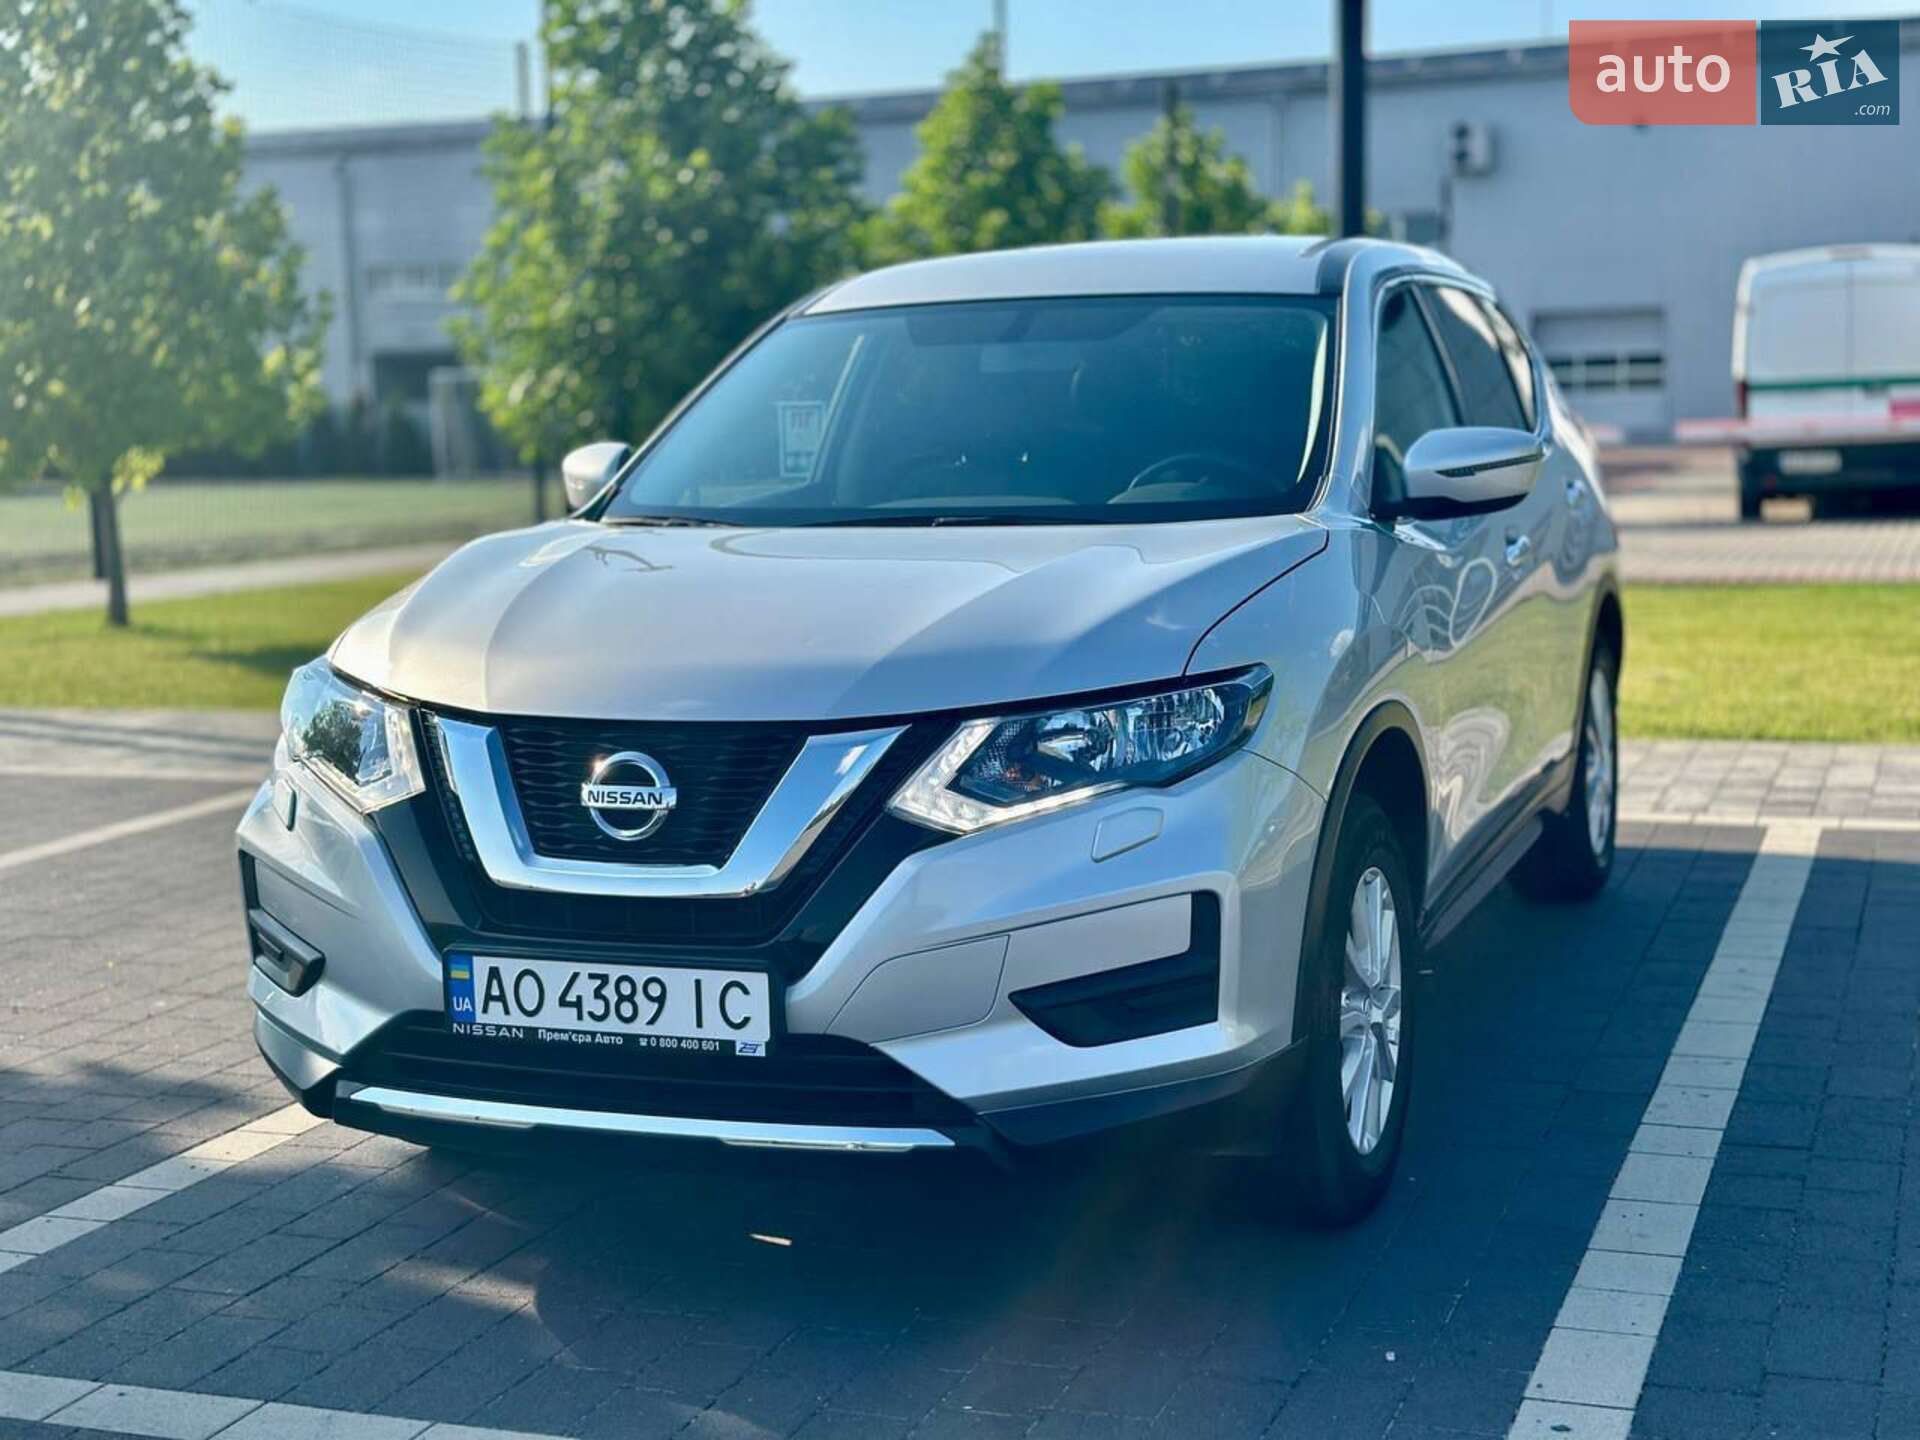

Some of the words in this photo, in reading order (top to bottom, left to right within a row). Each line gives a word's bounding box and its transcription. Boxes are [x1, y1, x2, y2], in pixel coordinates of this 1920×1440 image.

[587, 790, 662, 805] NISSAN
[453, 996, 473, 1012] UA
[481, 965, 545, 1018] AO
[558, 971, 667, 1025] 4389
[694, 977, 751, 1030] IC
[452, 1022, 524, 1039] NISSAN
[595, 1033, 624, 1045] Авто
[659, 1037, 679, 1049] 800
[680, 1039, 699, 1050] 400
